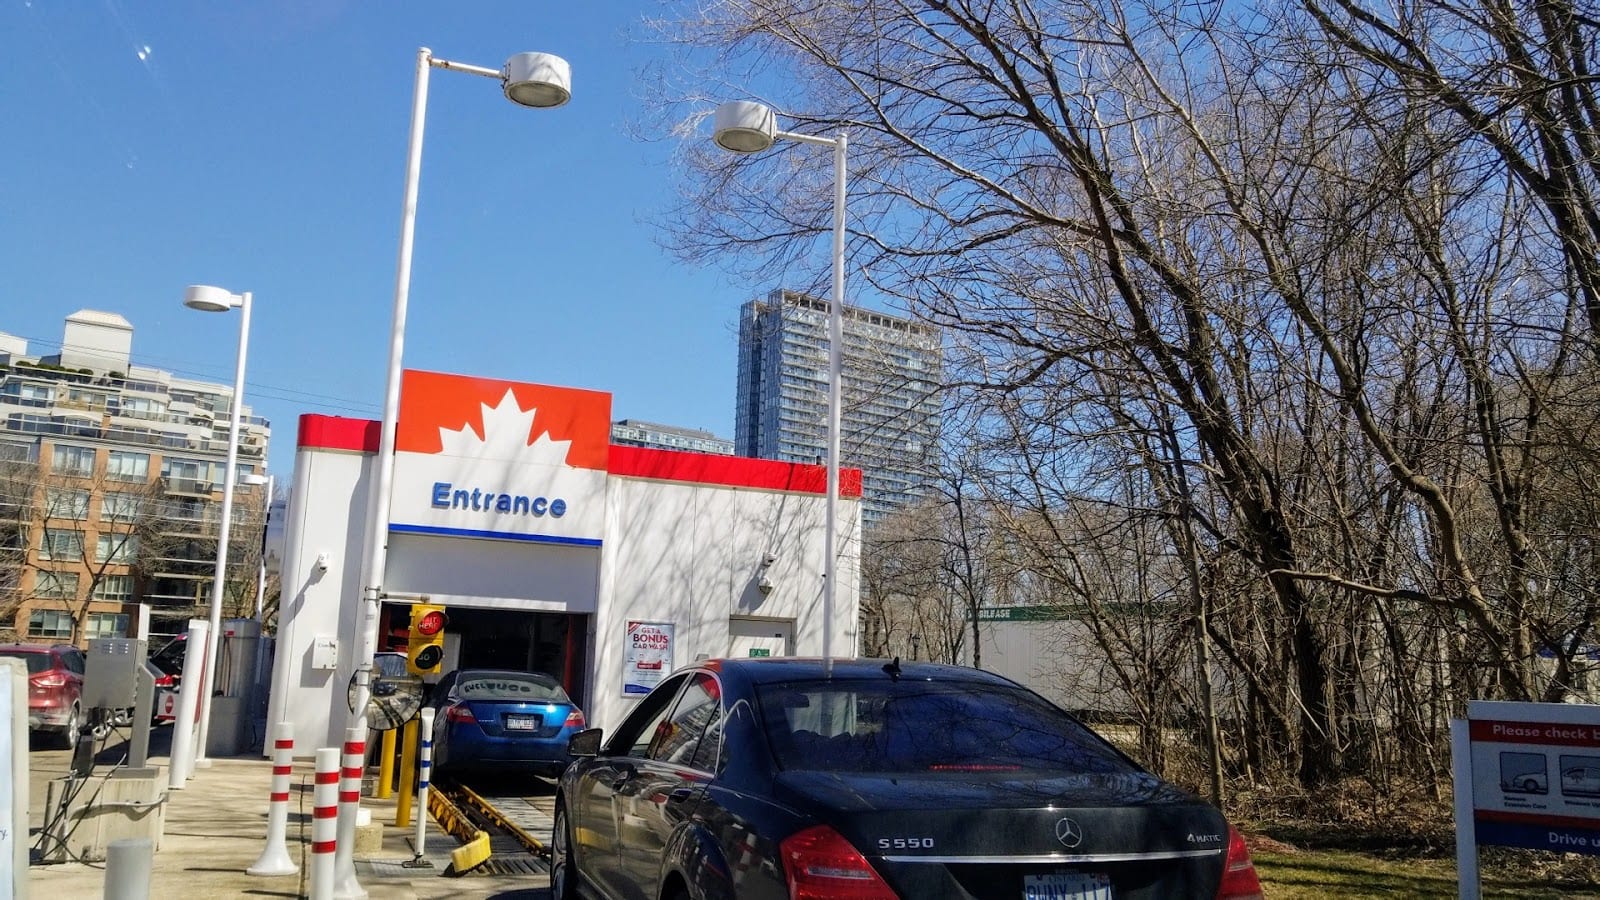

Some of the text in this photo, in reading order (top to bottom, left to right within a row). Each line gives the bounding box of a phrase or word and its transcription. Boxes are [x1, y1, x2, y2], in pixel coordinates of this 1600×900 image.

[431, 482, 567, 518] Entrance
[633, 633, 669, 643] BONUS
[1492, 724, 1540, 737] Please
[1545, 727, 1588, 740] check
[878, 838, 934, 849] S 550
[1548, 832, 1586, 846] Drive
